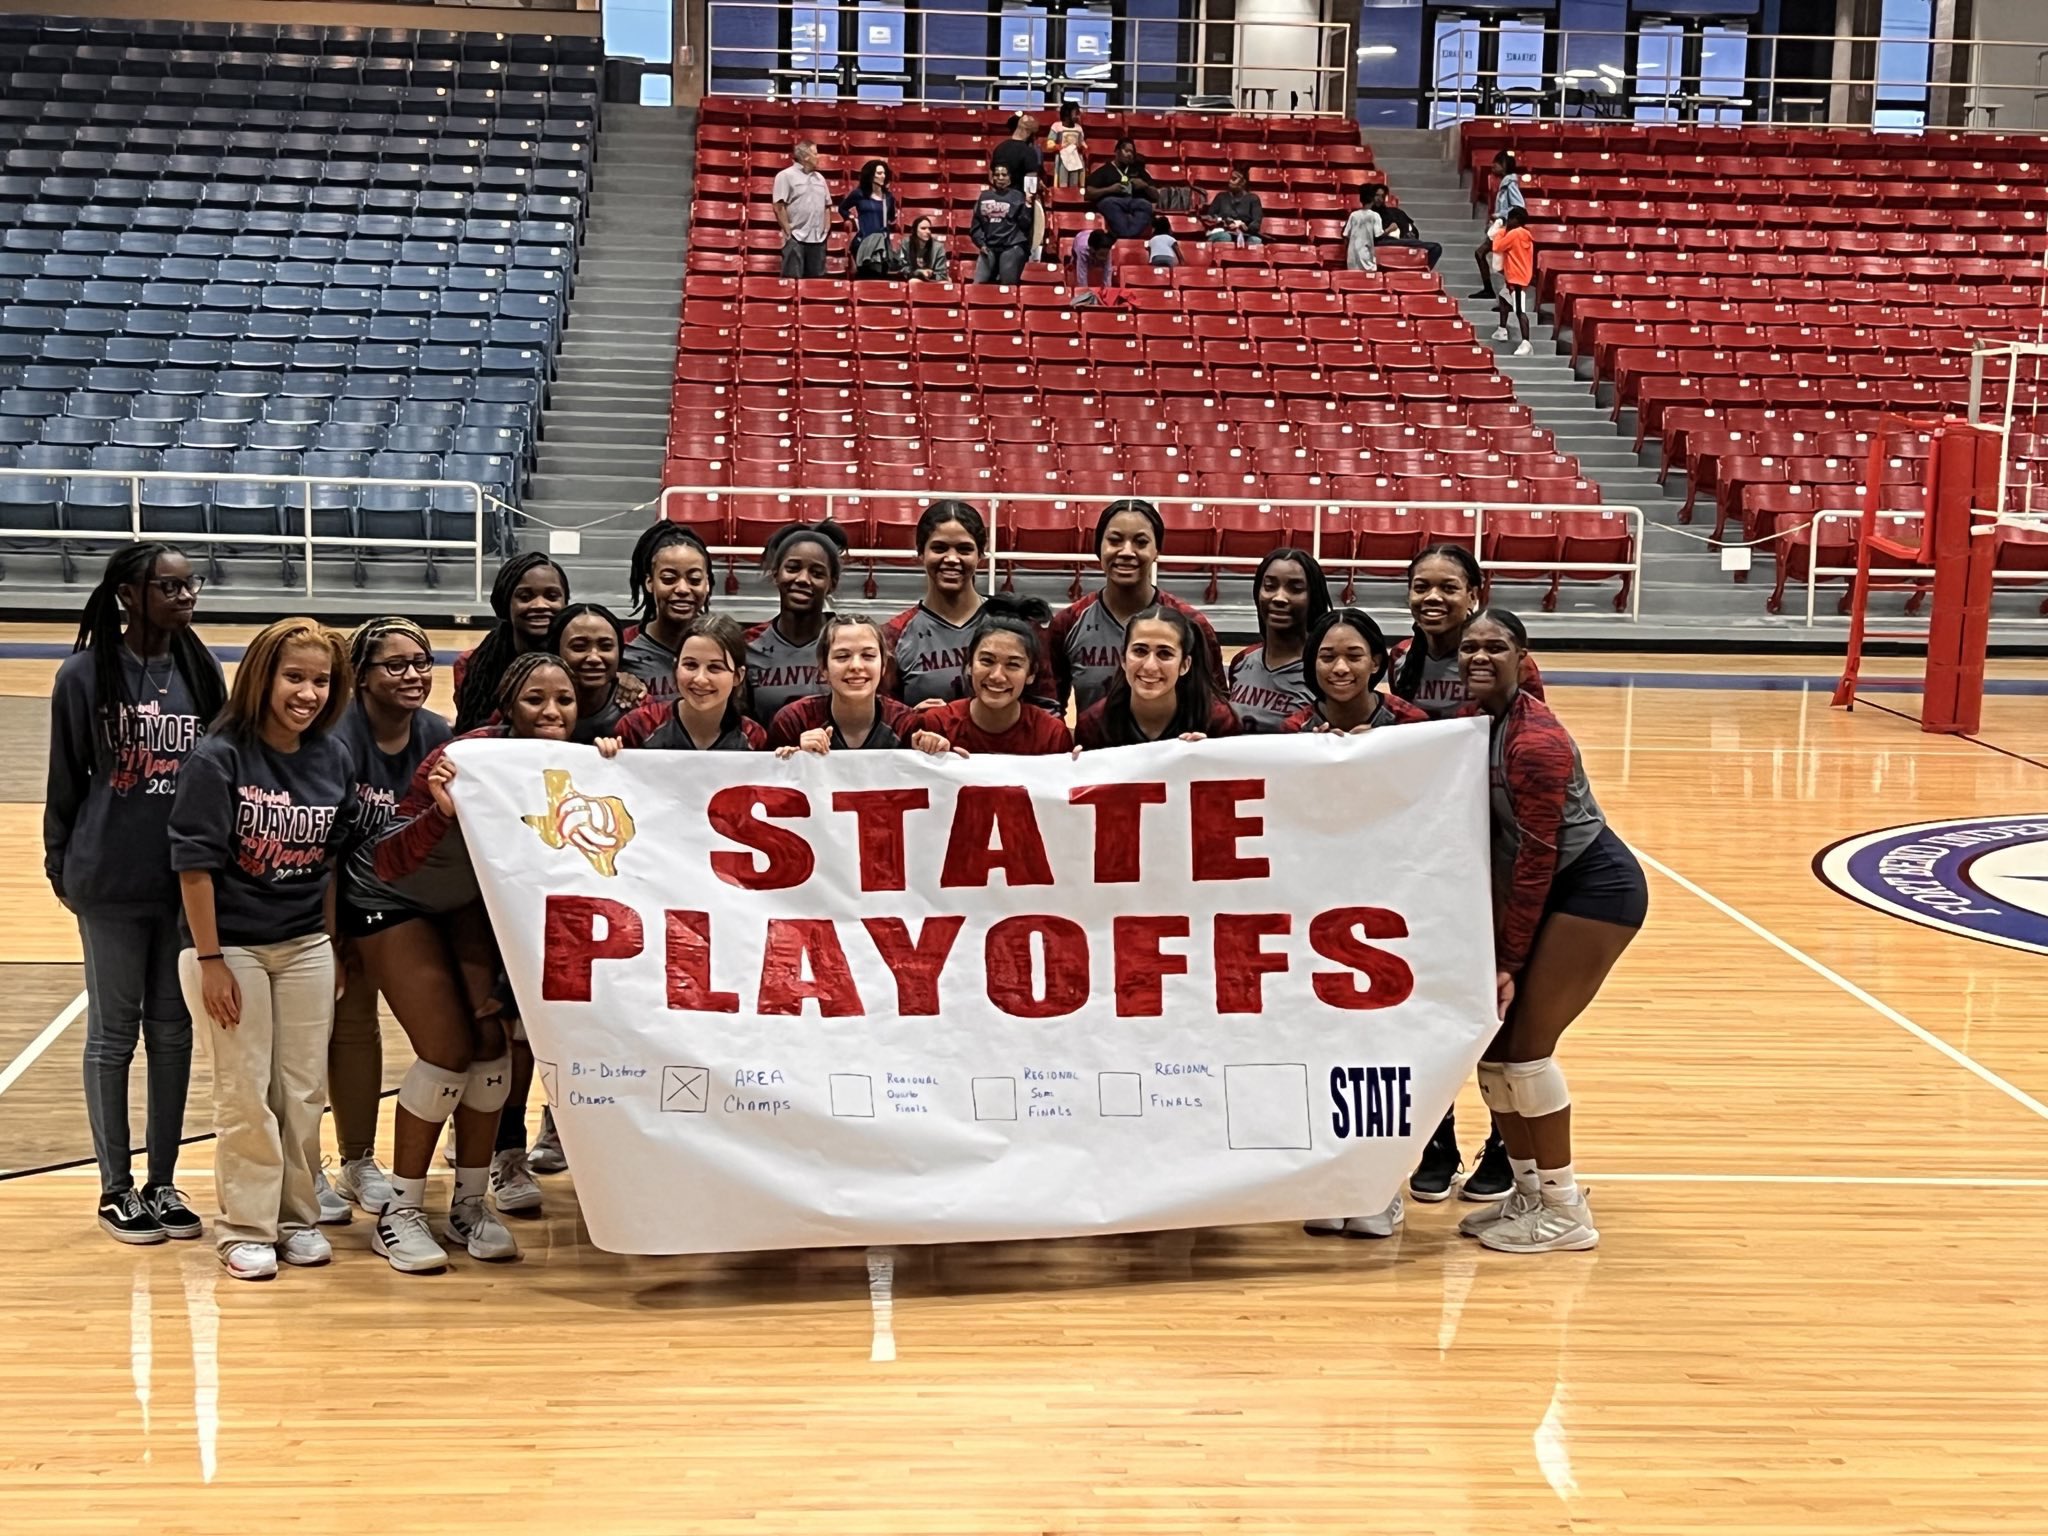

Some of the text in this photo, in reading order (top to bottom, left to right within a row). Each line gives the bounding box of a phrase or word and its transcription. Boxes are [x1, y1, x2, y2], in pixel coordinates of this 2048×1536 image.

[1229, 682, 1295, 715] MANVEL
[707, 778, 1271, 892] STATE
[1878, 844, 1950, 877] BEND
[1883, 876, 2002, 915] FORT
[542, 894, 1416, 1020] PLAYOFFS
[735, 1068, 785, 1087] AREA
[723, 1094, 791, 1116] Champs
[1330, 1066, 1411, 1139] STATE
